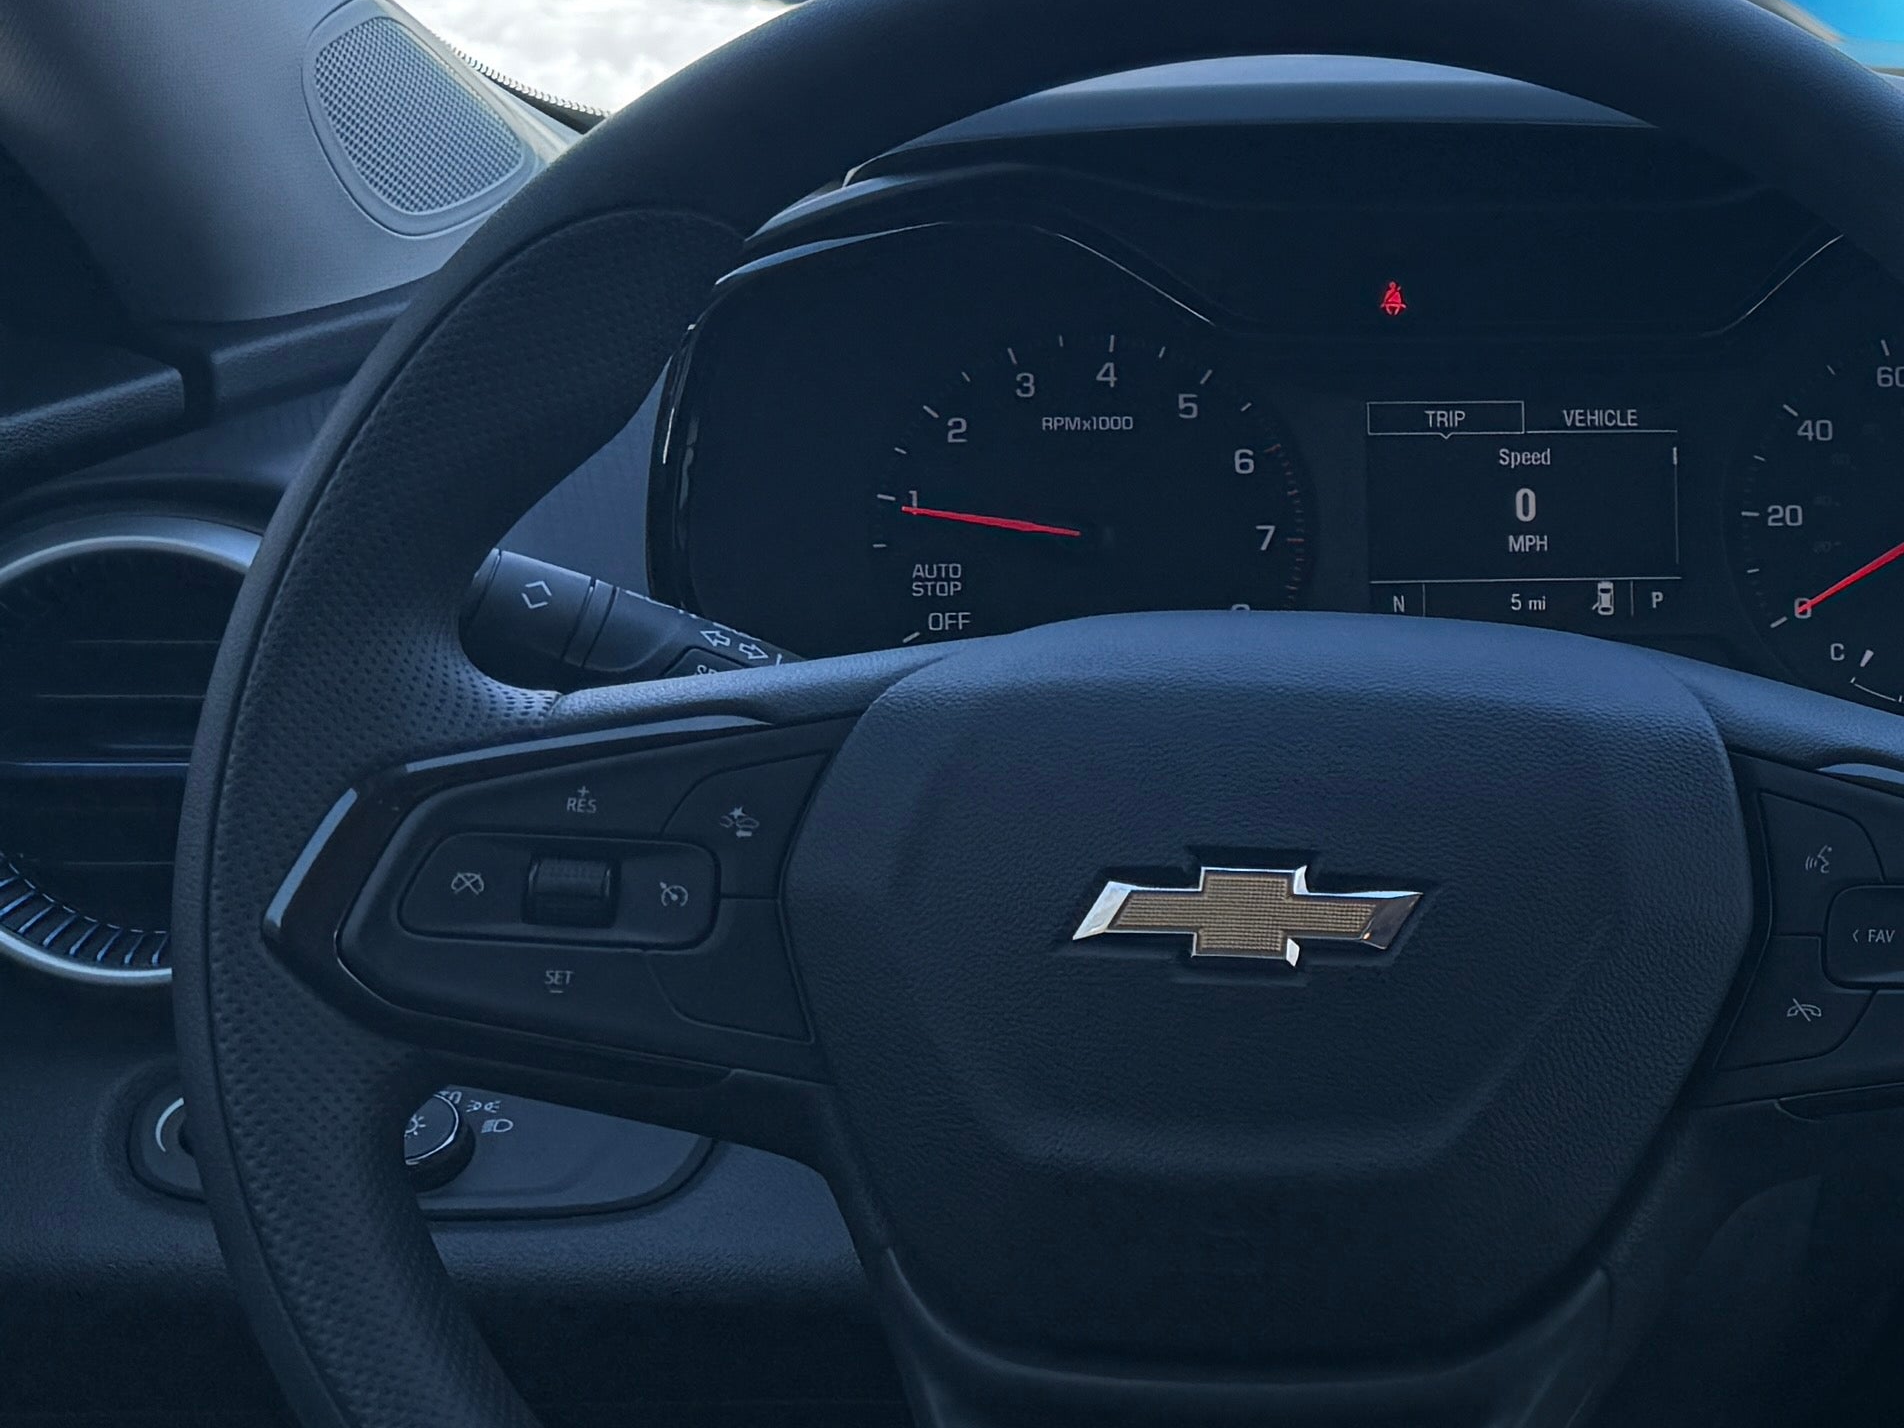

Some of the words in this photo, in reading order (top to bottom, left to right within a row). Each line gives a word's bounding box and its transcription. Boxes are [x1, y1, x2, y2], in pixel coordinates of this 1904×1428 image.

[1095, 361, 1118, 388] 4
[1015, 371, 1036, 398] 3
[1177, 393, 1199, 420] 5
[1041, 415, 1134, 432] RPMx1000
[1424, 409, 1466, 428] TRIP
[1562, 408, 1639, 428] VEHICLE
[946, 417, 968, 444] 2
[1797, 419, 1834, 442] 40
[1232, 447, 1255, 475] 6
[1499, 447, 1552, 470] Speed
[1514, 487, 1537, 523] 0
[1767, 504, 1803, 527] 20
[1256, 524, 1276, 551] 7
[1508, 534, 1549, 553] MPH
[911, 563, 963, 580] AUTO
[911, 581, 963, 598] STOP
[1392, 595, 1405, 613] N
[1510, 593, 1522, 611] 5
[1528, 595, 1547, 611] mi
[1651, 591, 1664, 609] P
[927, 611, 972, 632] OFF
[1830, 642, 1846, 661] C
[566, 796, 597, 814] RES
[1867, 928, 1896, 944] FAV
[544, 969, 574, 987] SET
